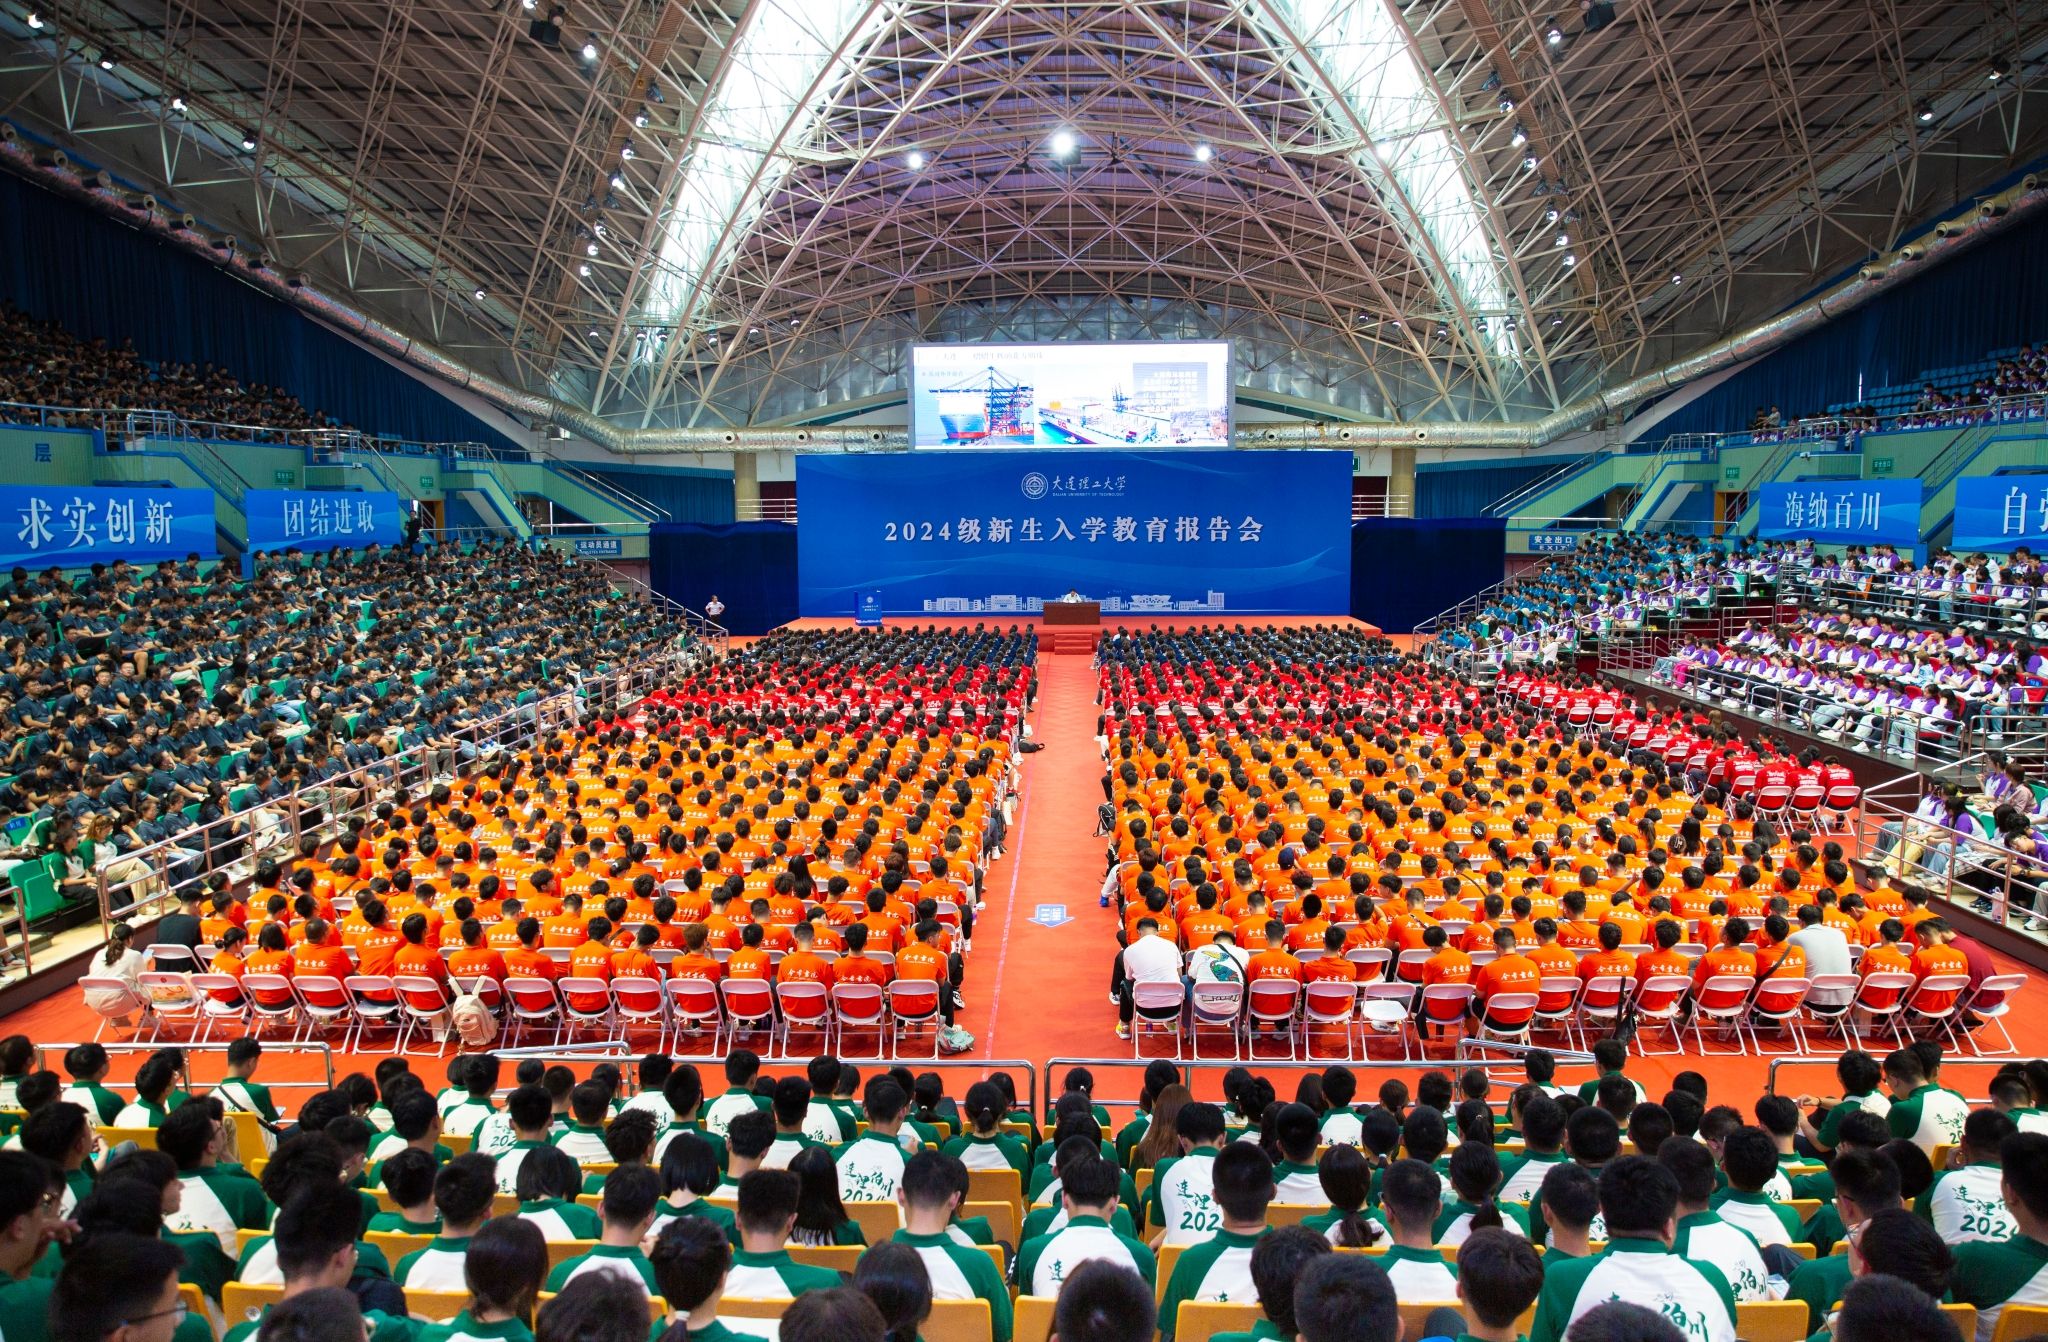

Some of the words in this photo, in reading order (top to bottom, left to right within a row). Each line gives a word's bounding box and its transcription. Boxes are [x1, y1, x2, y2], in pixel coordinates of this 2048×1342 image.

[34, 443, 52, 463] 层
[1052, 475, 1126, 491] 大连理工大学
[283, 498, 376, 538] 团结进取
[1785, 491, 1881, 532] 海纳百川
[17, 496, 174, 549] 求实创新
[884, 516, 1264, 544] 2024级新生入学教育报告会
[580, 540, 617, 549] 运动员通道
[1534, 535, 1572, 544] 安全出口
[1180, 1211, 1220, 1232] 202
